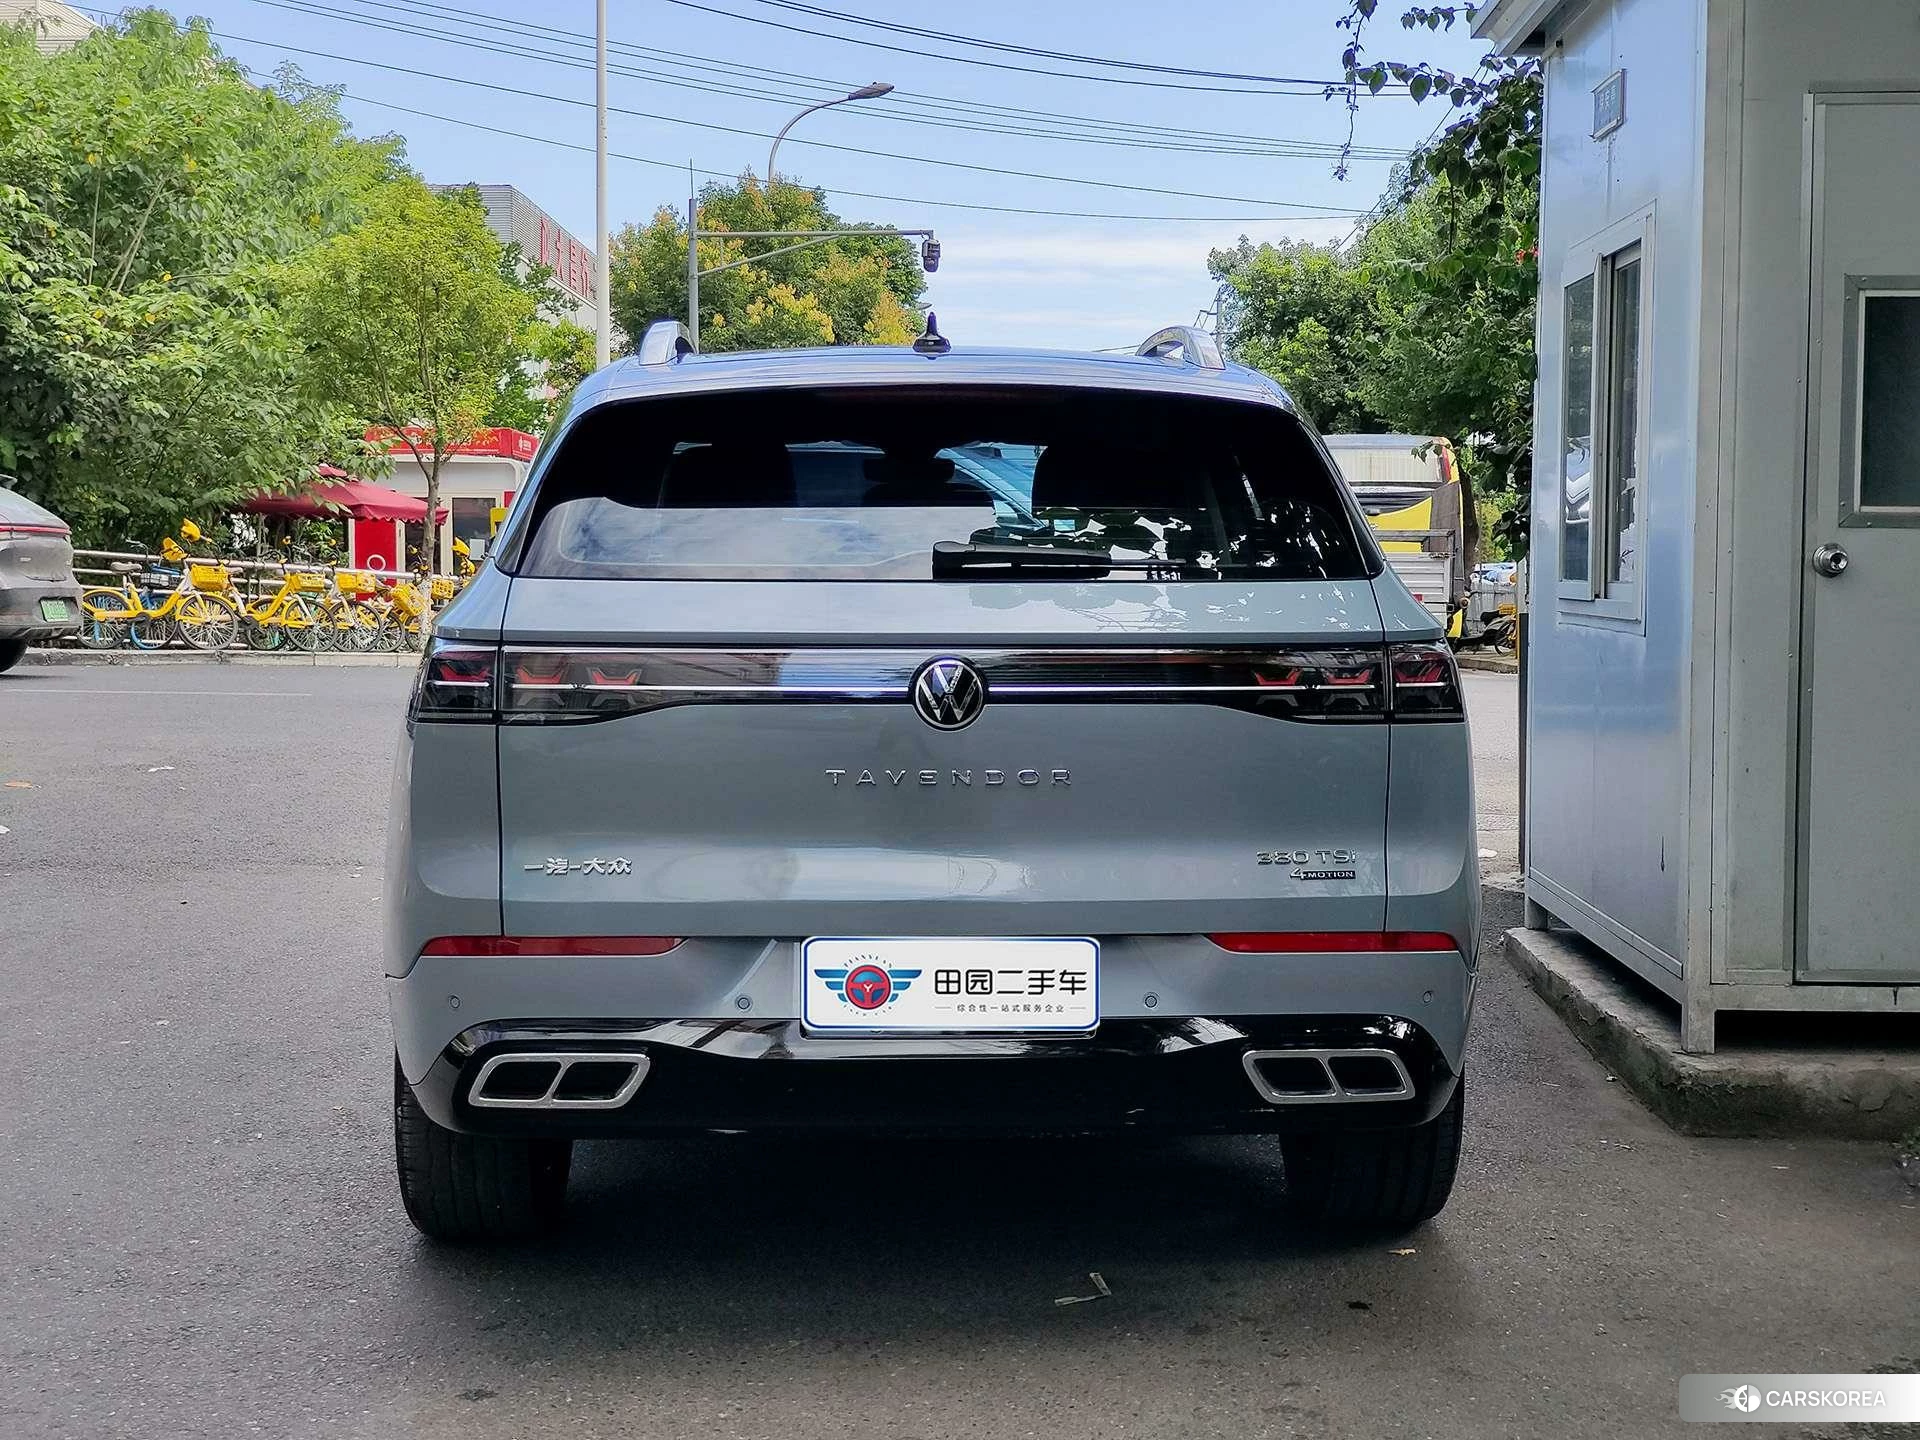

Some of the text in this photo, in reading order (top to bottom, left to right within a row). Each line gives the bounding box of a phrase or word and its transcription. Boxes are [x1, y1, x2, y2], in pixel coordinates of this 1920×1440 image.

[825, 768, 1074, 786] TAVENDOR
[1256, 849, 1310, 865] 380
[1290, 867, 1356, 880] 4MOTION
[863, 983, 873, 992] Y
[934, 968, 1088, 996] 田园二手车
[956, 1003, 1065, 1013] 综合性一站式服务企业
